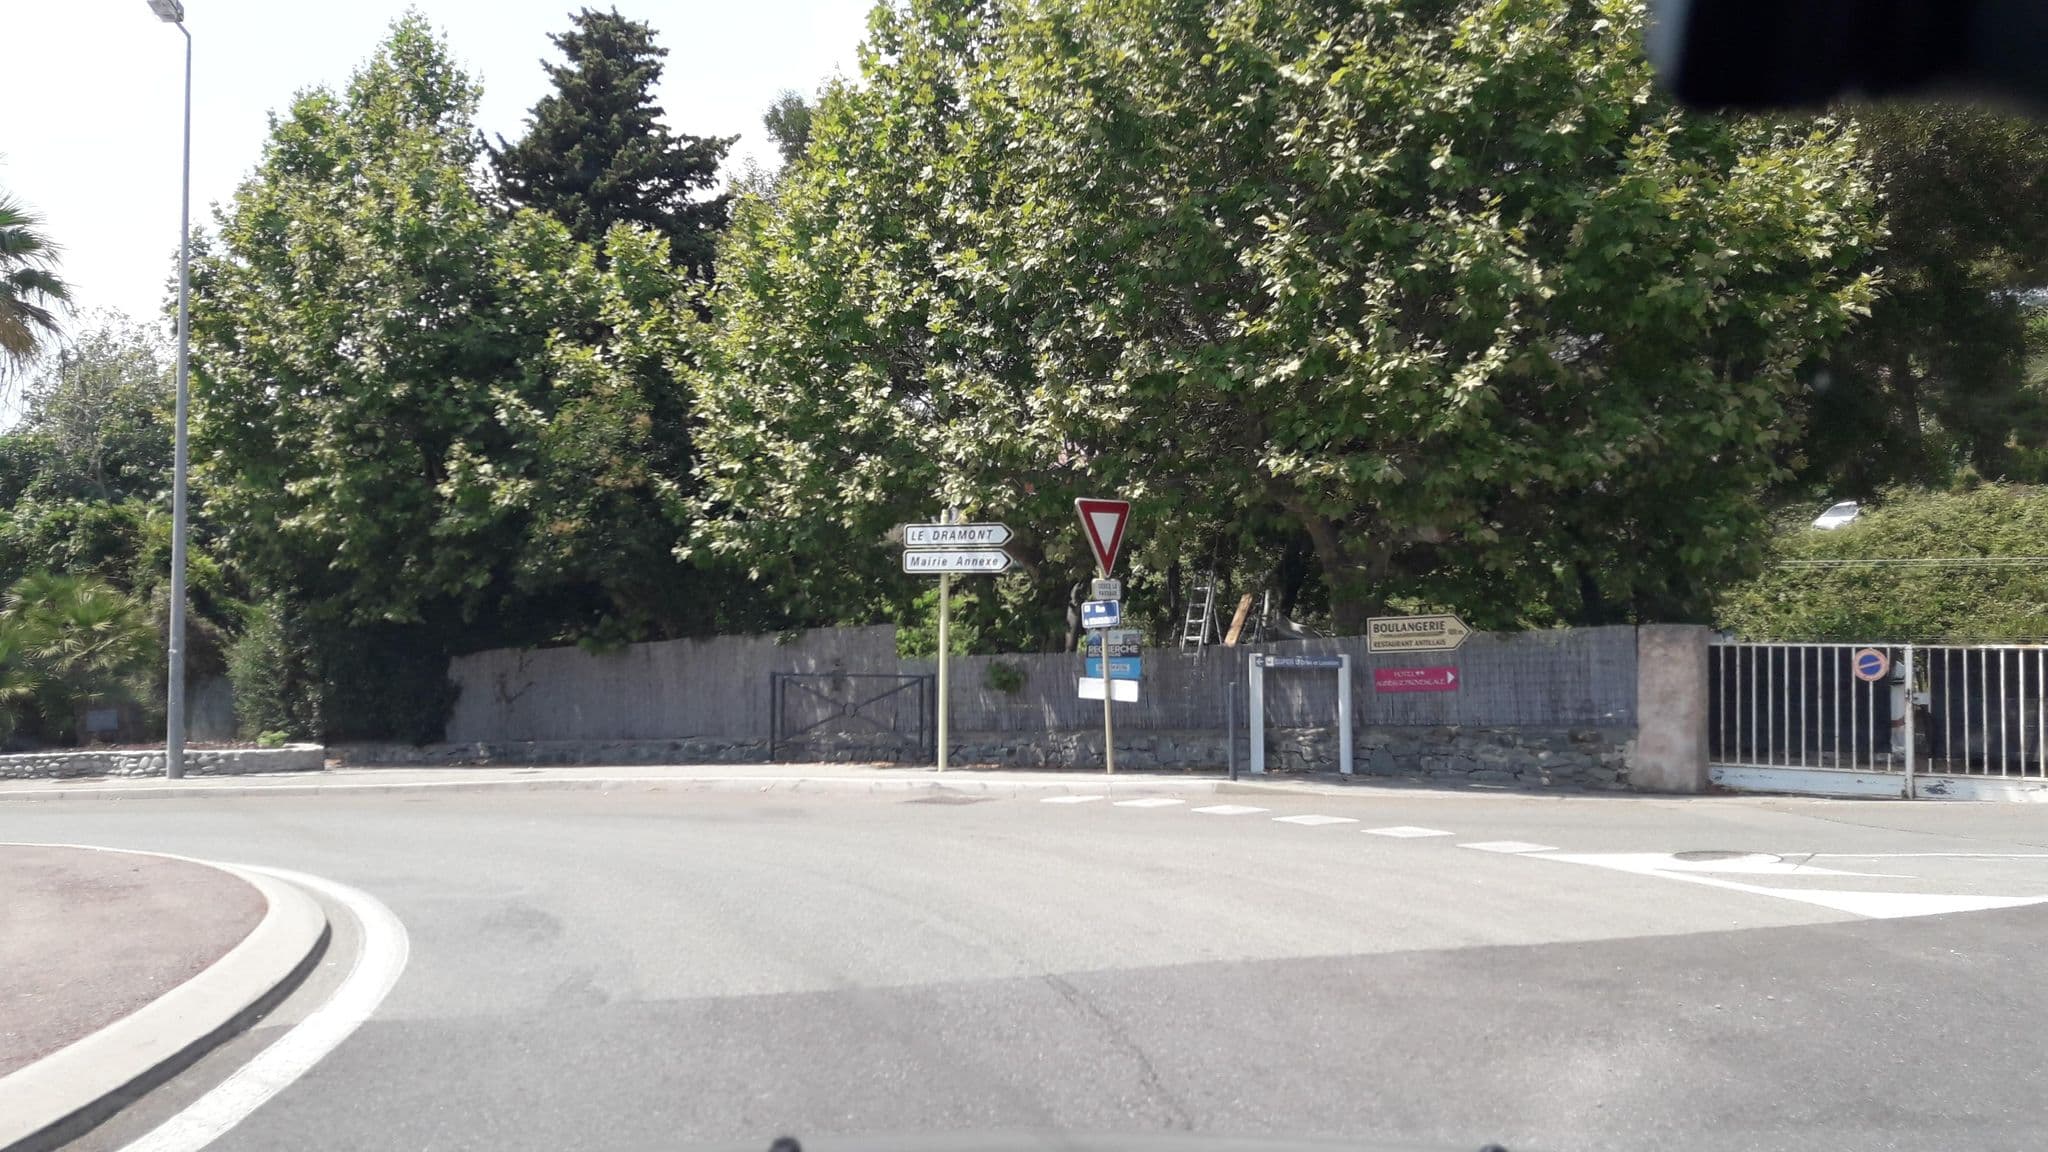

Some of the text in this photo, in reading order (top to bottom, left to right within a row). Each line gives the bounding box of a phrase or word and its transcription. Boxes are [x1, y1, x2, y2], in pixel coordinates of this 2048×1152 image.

[911, 529, 994, 541] LE DRAMONT
[910, 556, 999, 567] Mairie Annexe
[1373, 620, 1446, 634] BOULANGERIE
[1373, 639, 1413, 649] RESTAURANT
